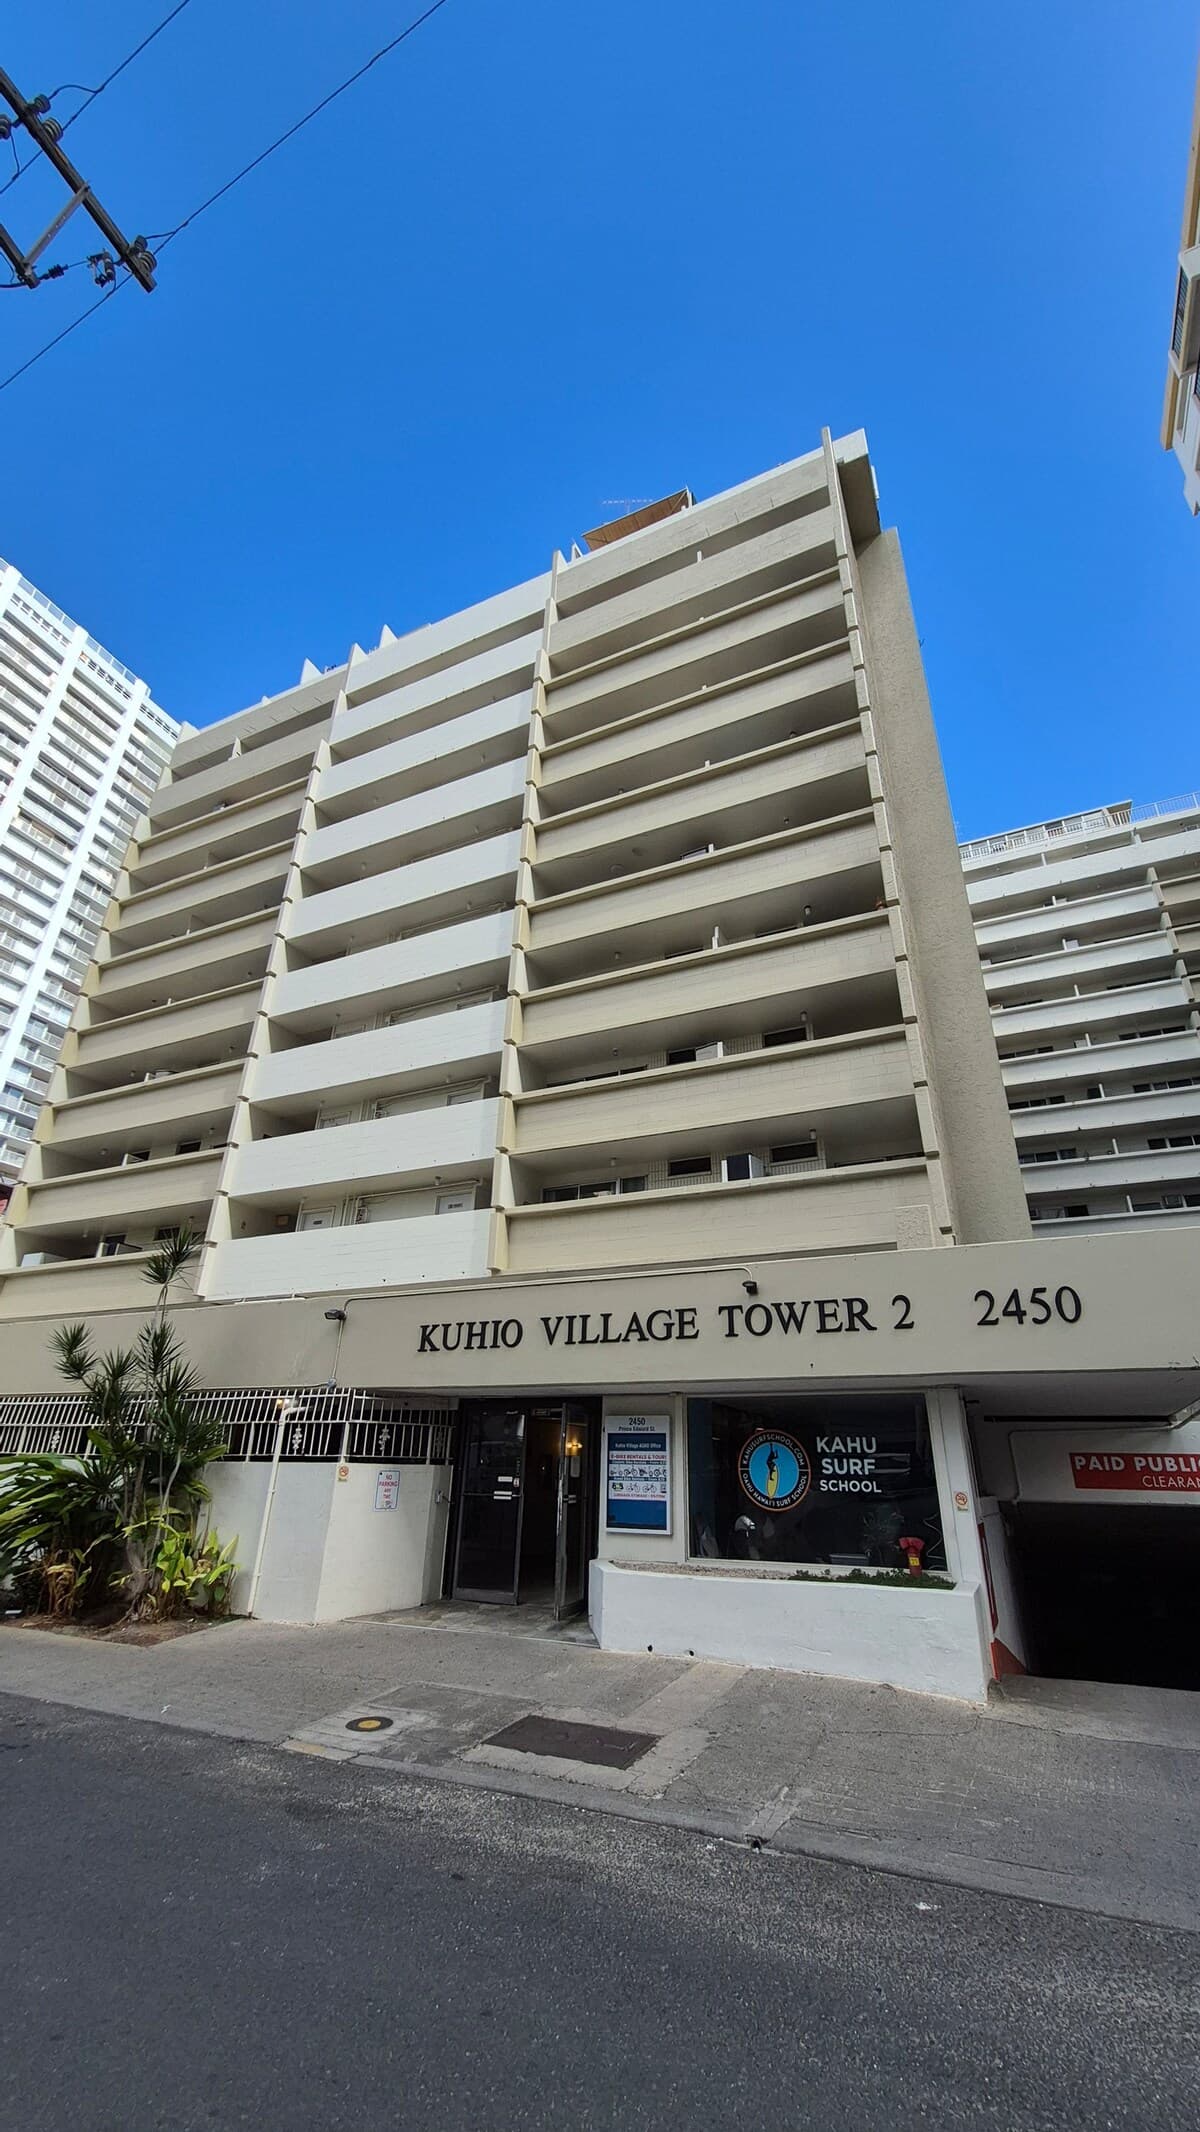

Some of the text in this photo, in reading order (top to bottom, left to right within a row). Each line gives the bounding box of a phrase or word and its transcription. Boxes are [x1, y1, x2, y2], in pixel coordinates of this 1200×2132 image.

[417, 1286, 1083, 1352] KUHIO VILLAGE TOWER 2 2450
[629, 1417, 646, 1425] 2450
[742, 1433, 805, 1466] KAHUSURFSCHOOL.COM
[816, 1436, 877, 1454] KAHU
[821, 1457, 876, 1475] SURF
[1074, 1455, 1200, 1473] PAID PUBLI
[742, 1473, 754, 1493] OAHU
[776, 1498, 792, 1507] SURF
[791, 1475, 808, 1500] SCHOOL
[820, 1479, 883, 1493] SCHOOL
